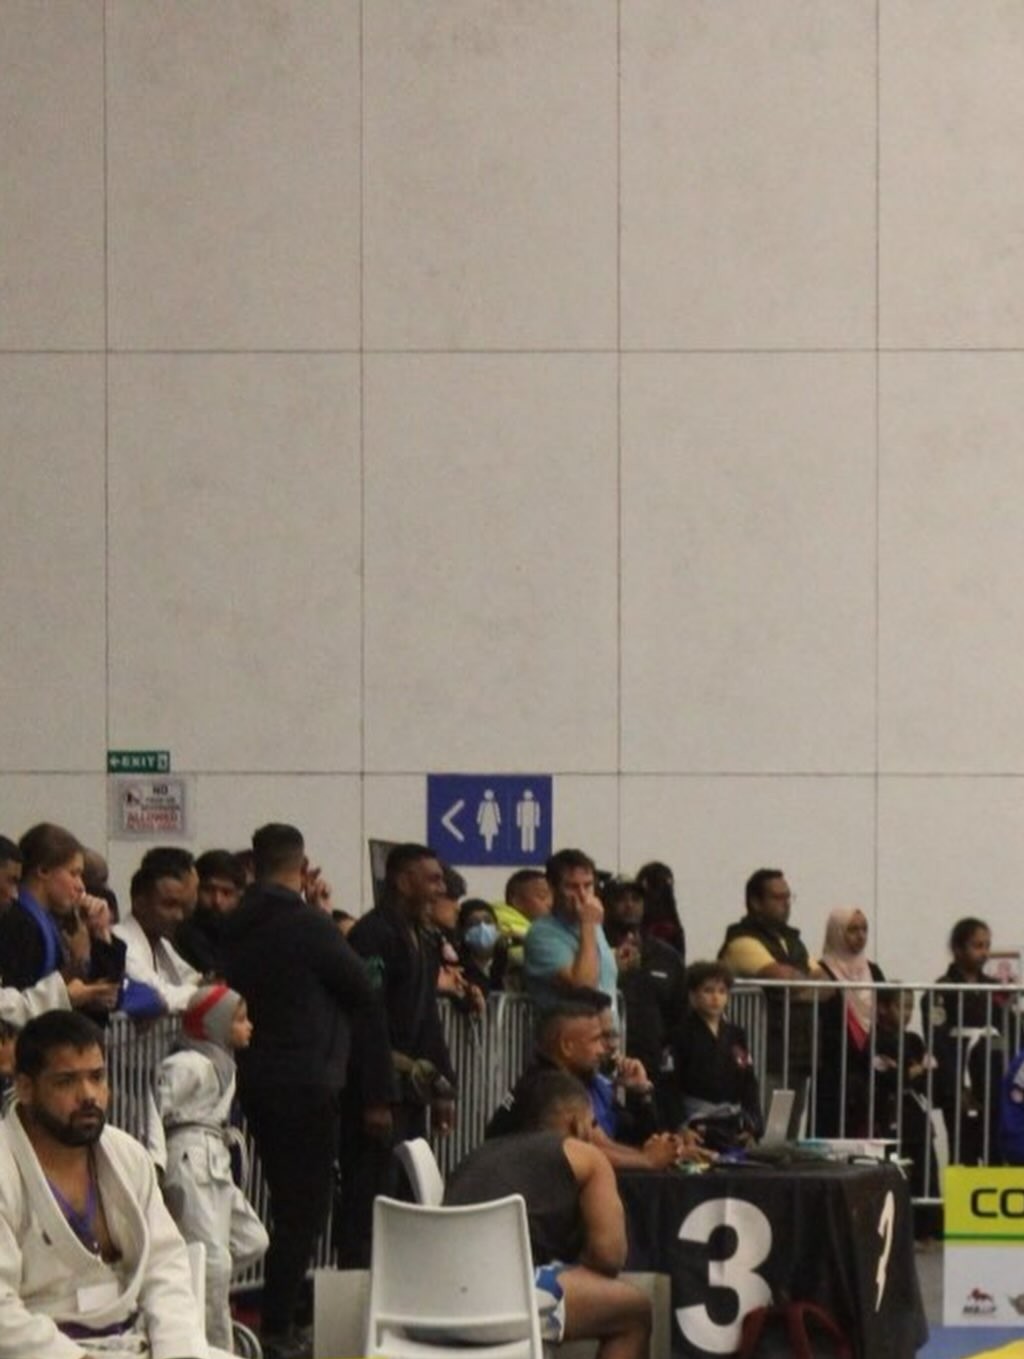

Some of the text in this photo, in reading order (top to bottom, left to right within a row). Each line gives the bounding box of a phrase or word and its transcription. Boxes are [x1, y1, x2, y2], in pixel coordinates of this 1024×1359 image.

[121, 755, 156, 768] EXIT
[152, 784, 169, 796] NO
[675, 1196, 773, 1355] 3
